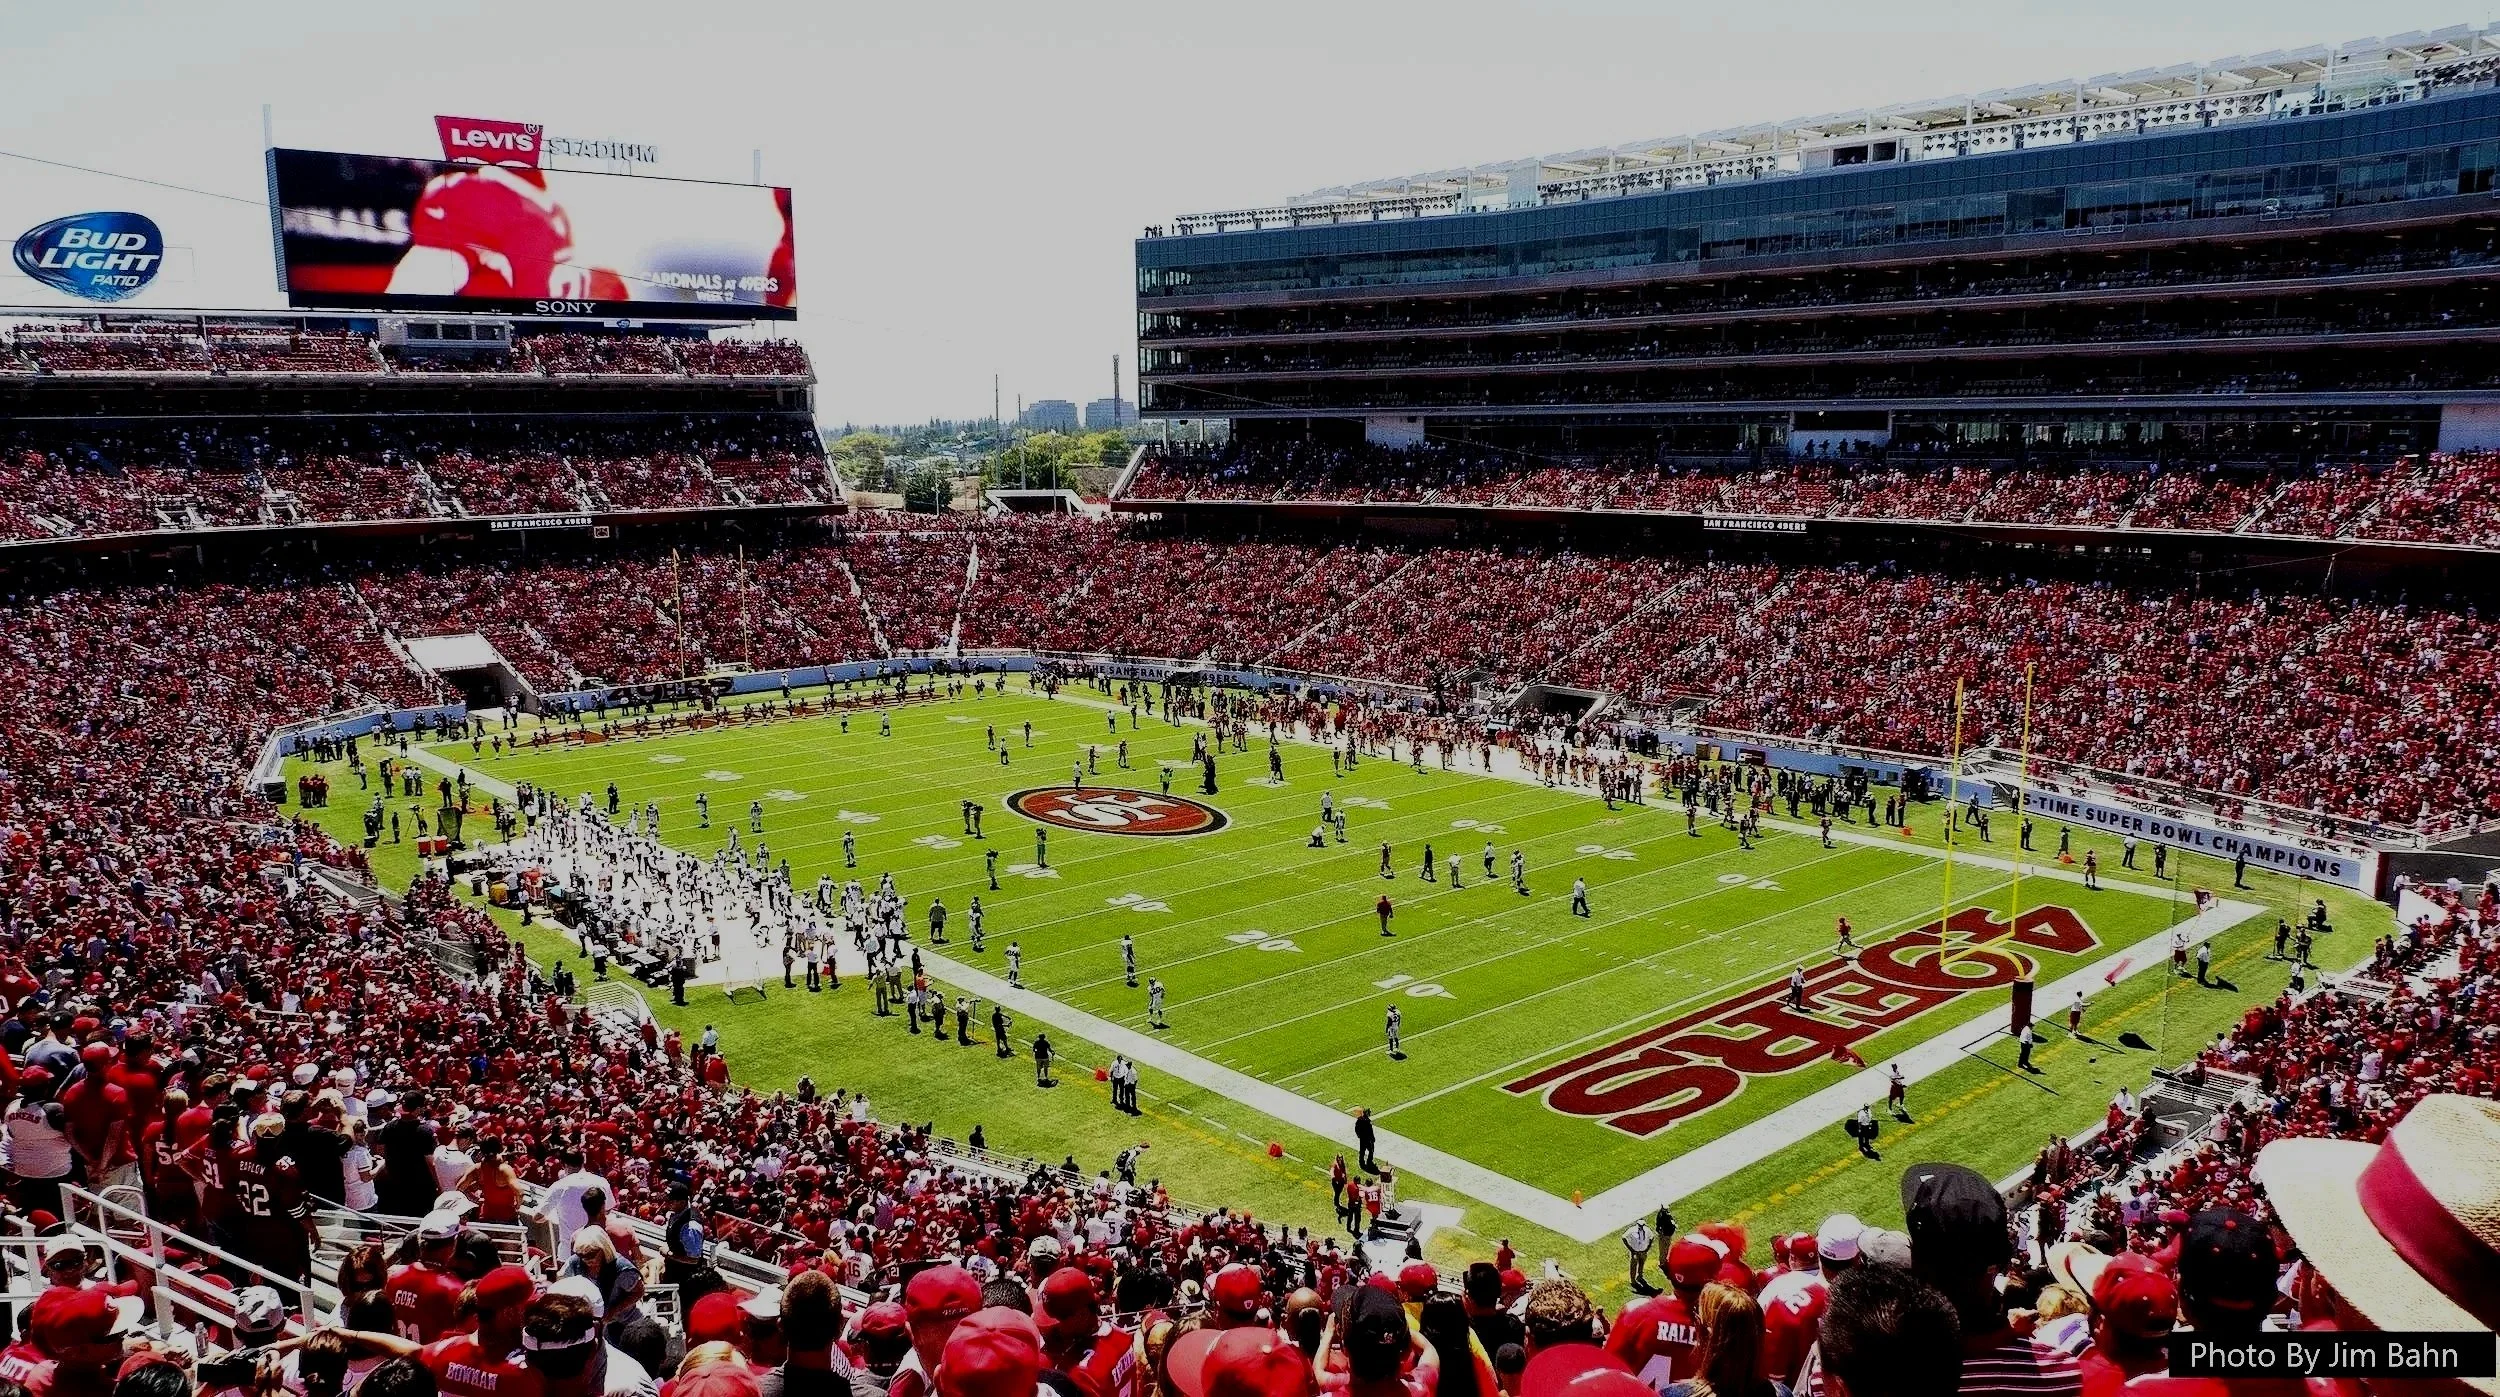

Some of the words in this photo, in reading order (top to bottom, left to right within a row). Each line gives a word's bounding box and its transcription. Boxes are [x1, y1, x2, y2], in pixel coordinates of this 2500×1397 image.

[549, 136, 659, 163] STADIUM
[58, 227, 147, 251] BUD
[38, 247, 160, 272] LIGHT
[91, 274, 140, 287] PATIO
[738, 275, 779, 293] 49ERS
[535, 300, 597, 314] SONY
[490, 521, 510, 529] SAN
[511, 518, 563, 528] FRANCISCO
[564, 517, 592, 526] 49ERS
[1703, 519, 1721, 528] SAN
[1722, 520, 1775, 530] FRANCISCO
[1776, 522, 1807, 531] 49ERS
[2022, 792, 2080, 818] 5-TIME
[2085, 807, 2143, 832] SUPER
[2150, 821, 2204, 846] BOWL
[2212, 836, 2341, 877] CHAMPIONS
[1510, 903, 2104, 1139] 49ERS
[202, 1158, 224, 1189] 21
[236, 1180, 272, 1217] 32
[1108, 1221, 1116, 1235] 5
[848, 1261, 860, 1278] 16
[890, 1266, 900, 1277] 21
[394, 1289, 418, 1309] GORE
[445, 1361, 499, 1391] BOWMAN
